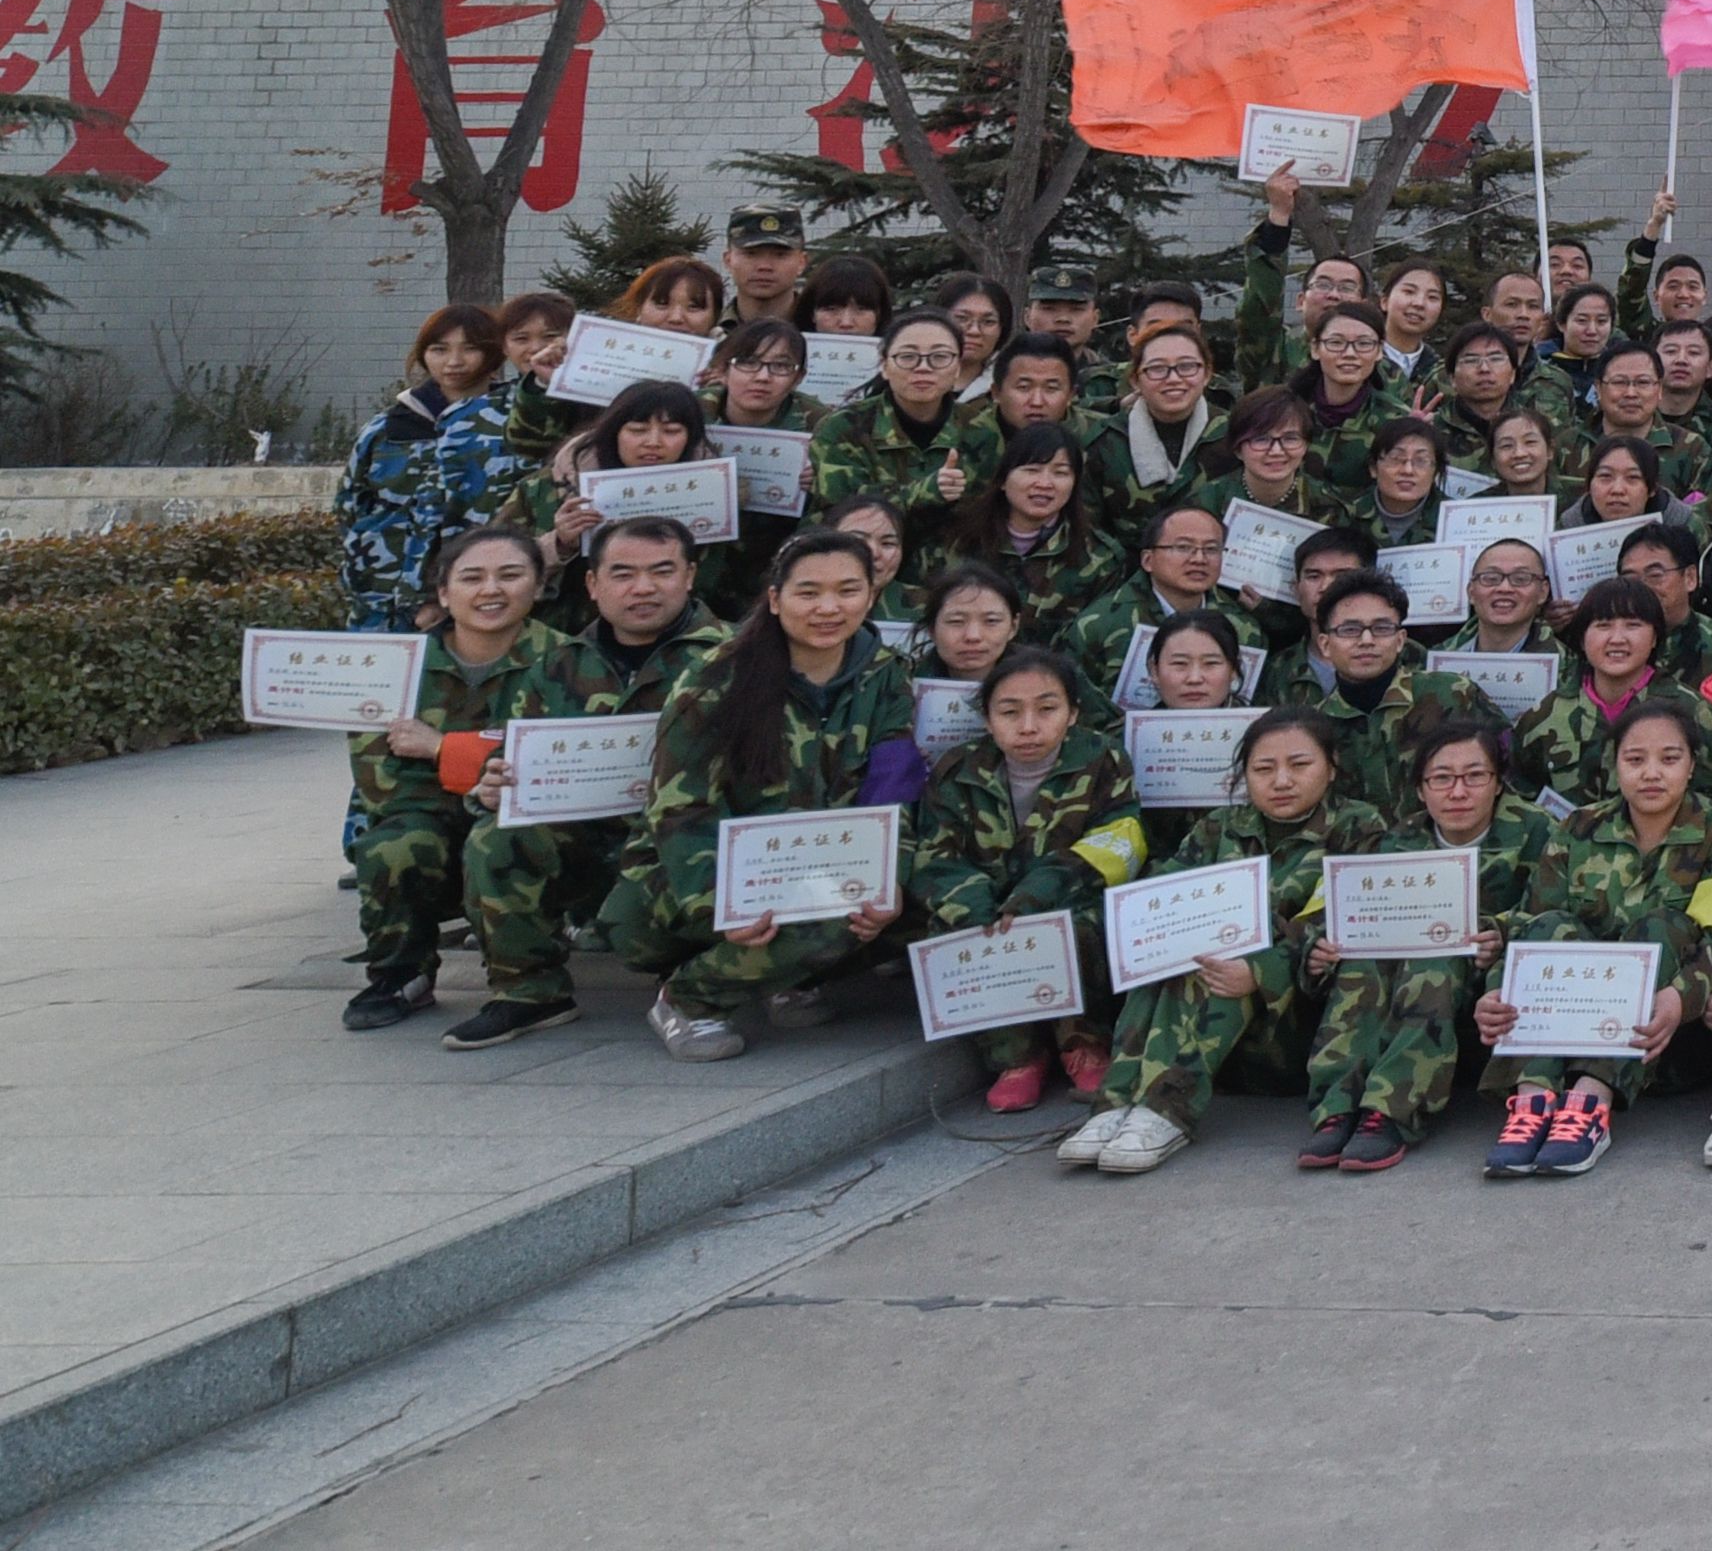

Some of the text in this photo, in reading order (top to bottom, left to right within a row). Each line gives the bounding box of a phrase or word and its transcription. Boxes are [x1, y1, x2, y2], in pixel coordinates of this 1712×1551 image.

[604, 338, 674, 361] 结业证书
[622, 479, 698, 499] 结业证书
[1467, 512, 1523, 526] 结业证书
[289, 651, 375, 668] 结业证书
[552, 734, 641, 754] 结业证书
[766, 830, 853, 852] 结业证书
[1361, 873, 1436, 891] 结业证书
[1147, 882, 1228, 913] 结业证书
[957, 936, 1037, 965] 结业证书
[1542, 965, 1617, 981] 结业证书
